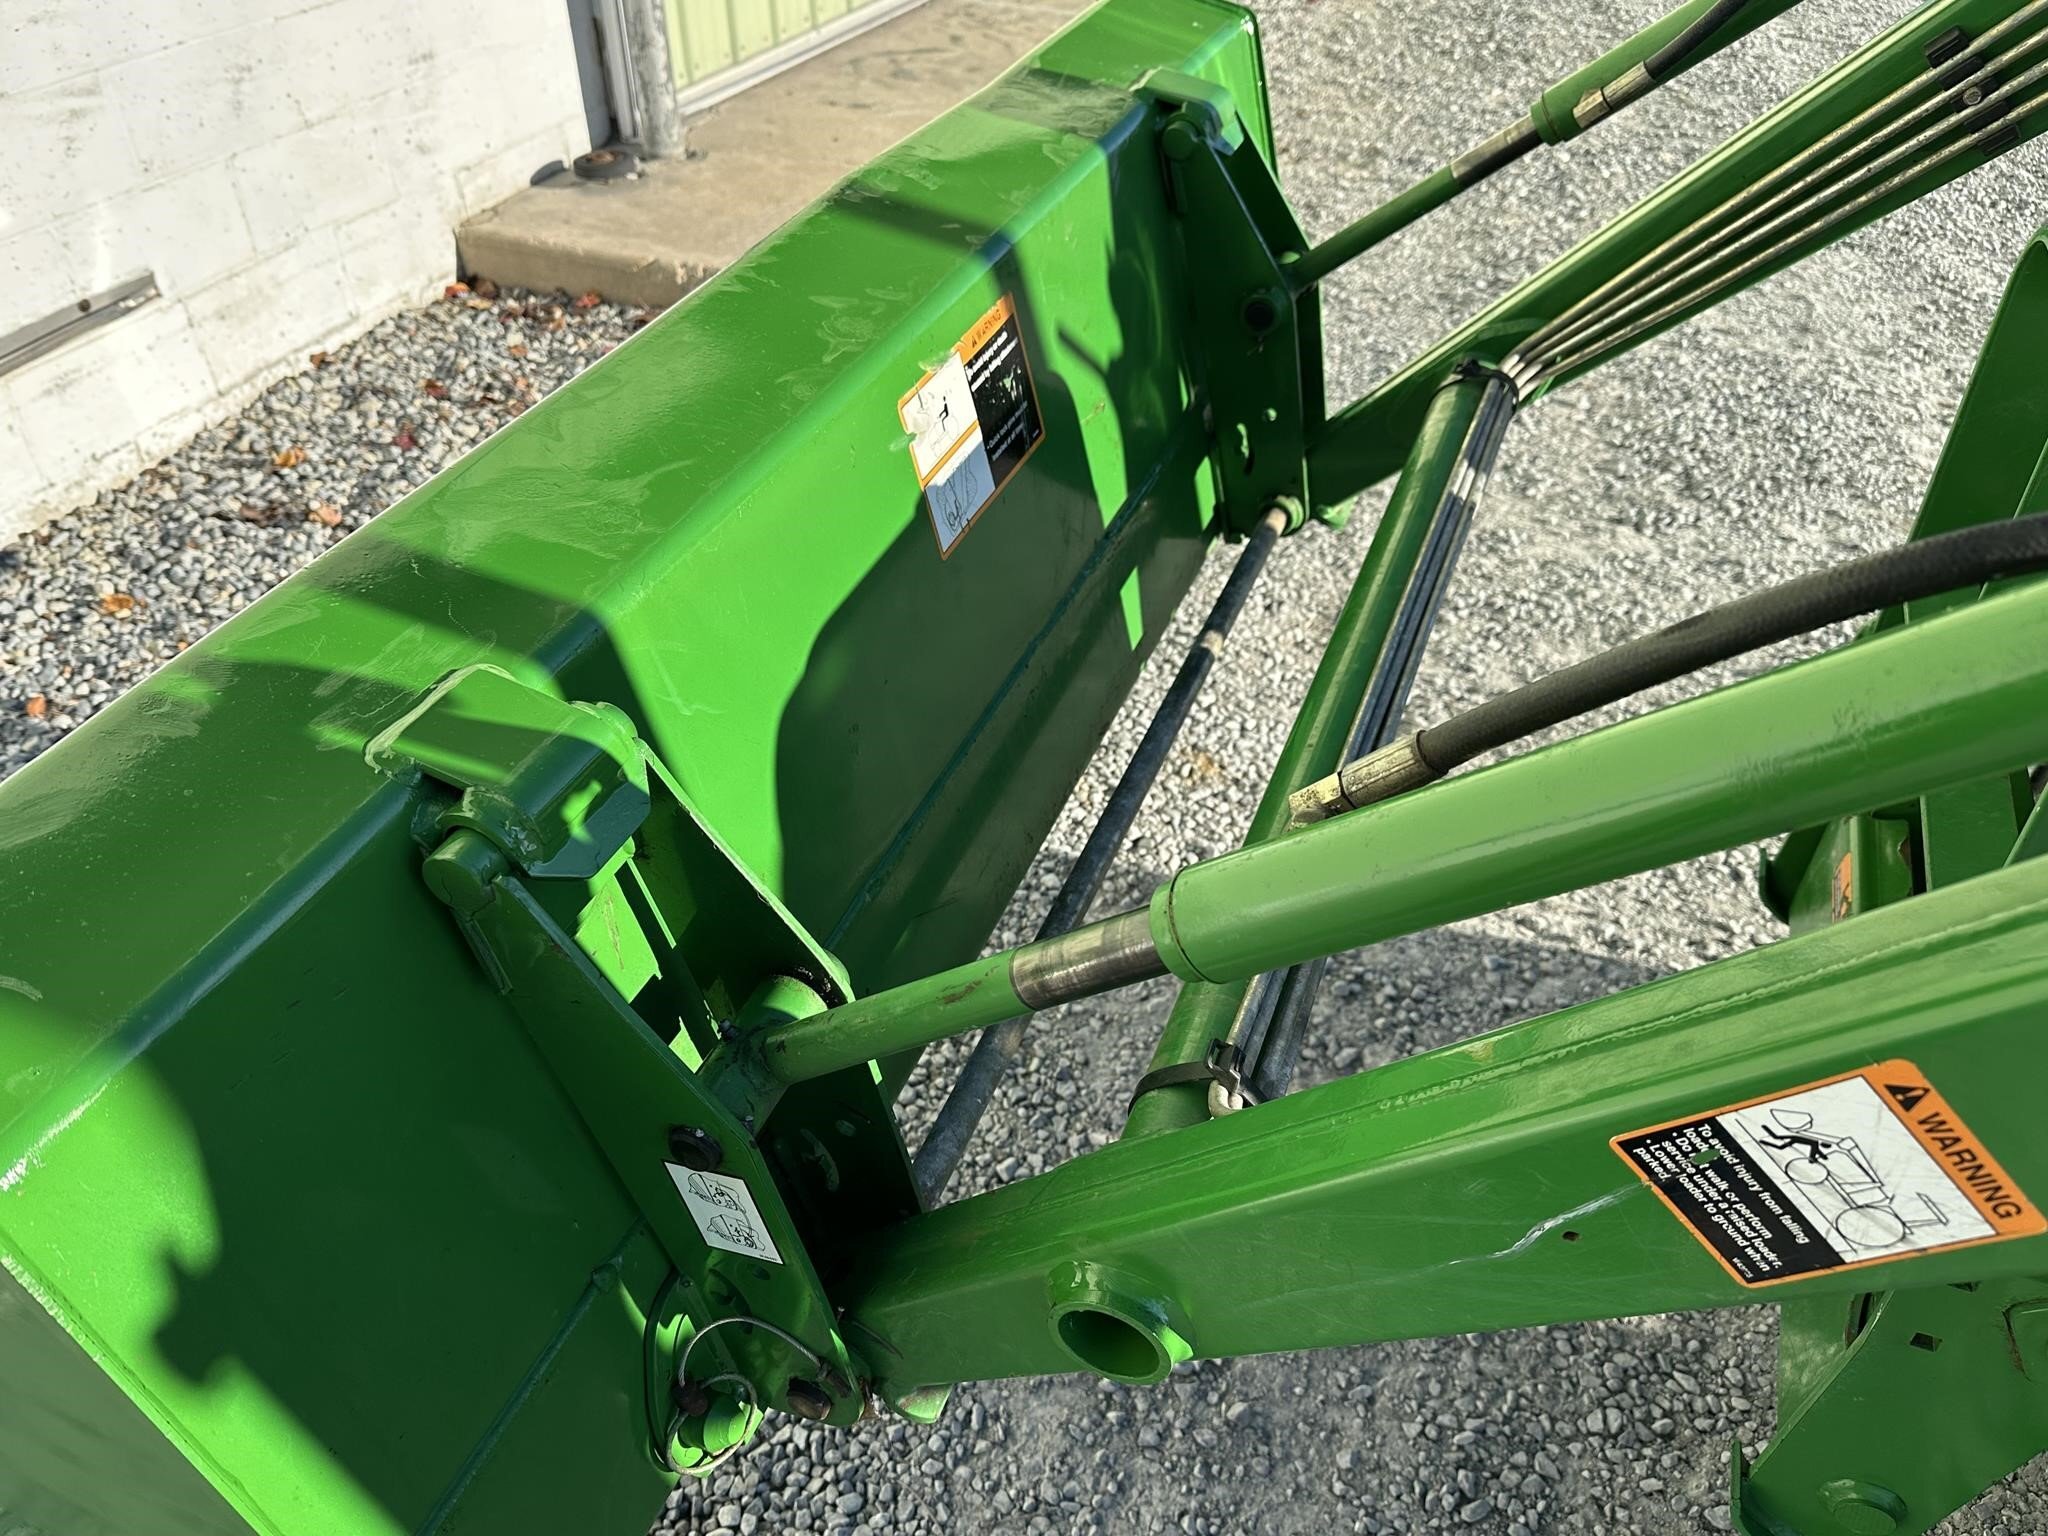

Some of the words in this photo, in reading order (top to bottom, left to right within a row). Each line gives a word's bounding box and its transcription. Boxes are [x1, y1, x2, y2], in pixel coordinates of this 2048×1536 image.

[1633, 1147, 1671, 1182] parked.
[1649, 1144, 1680, 1172] Lower
[1676, 1173, 1708, 1202] loader
[1704, 1203, 1717, 1213] to
[1711, 1214, 1750, 1246] ground
[1662, 1141, 1696, 1174] service
[1693, 1174, 1722, 1200] under
[1725, 1210, 1758, 1237] raised
[1751, 1238, 1782, 1268] loader.
[1675, 1137, 1692, 1151] Do
[1705, 1169, 1729, 1191] walk
[1725, 1192, 1739, 1202] or
[1732, 1203, 1772, 1239] perform
[1698, 1123, 1712, 1138] To
[1708, 1138, 1740, 1164] avoid
[1733, 1164, 1763, 1191] injury
[1758, 1192, 1783, 1214] from
[1779, 1215, 1811, 1244] falling
[1917, 1112, 2022, 1220] WARNING
